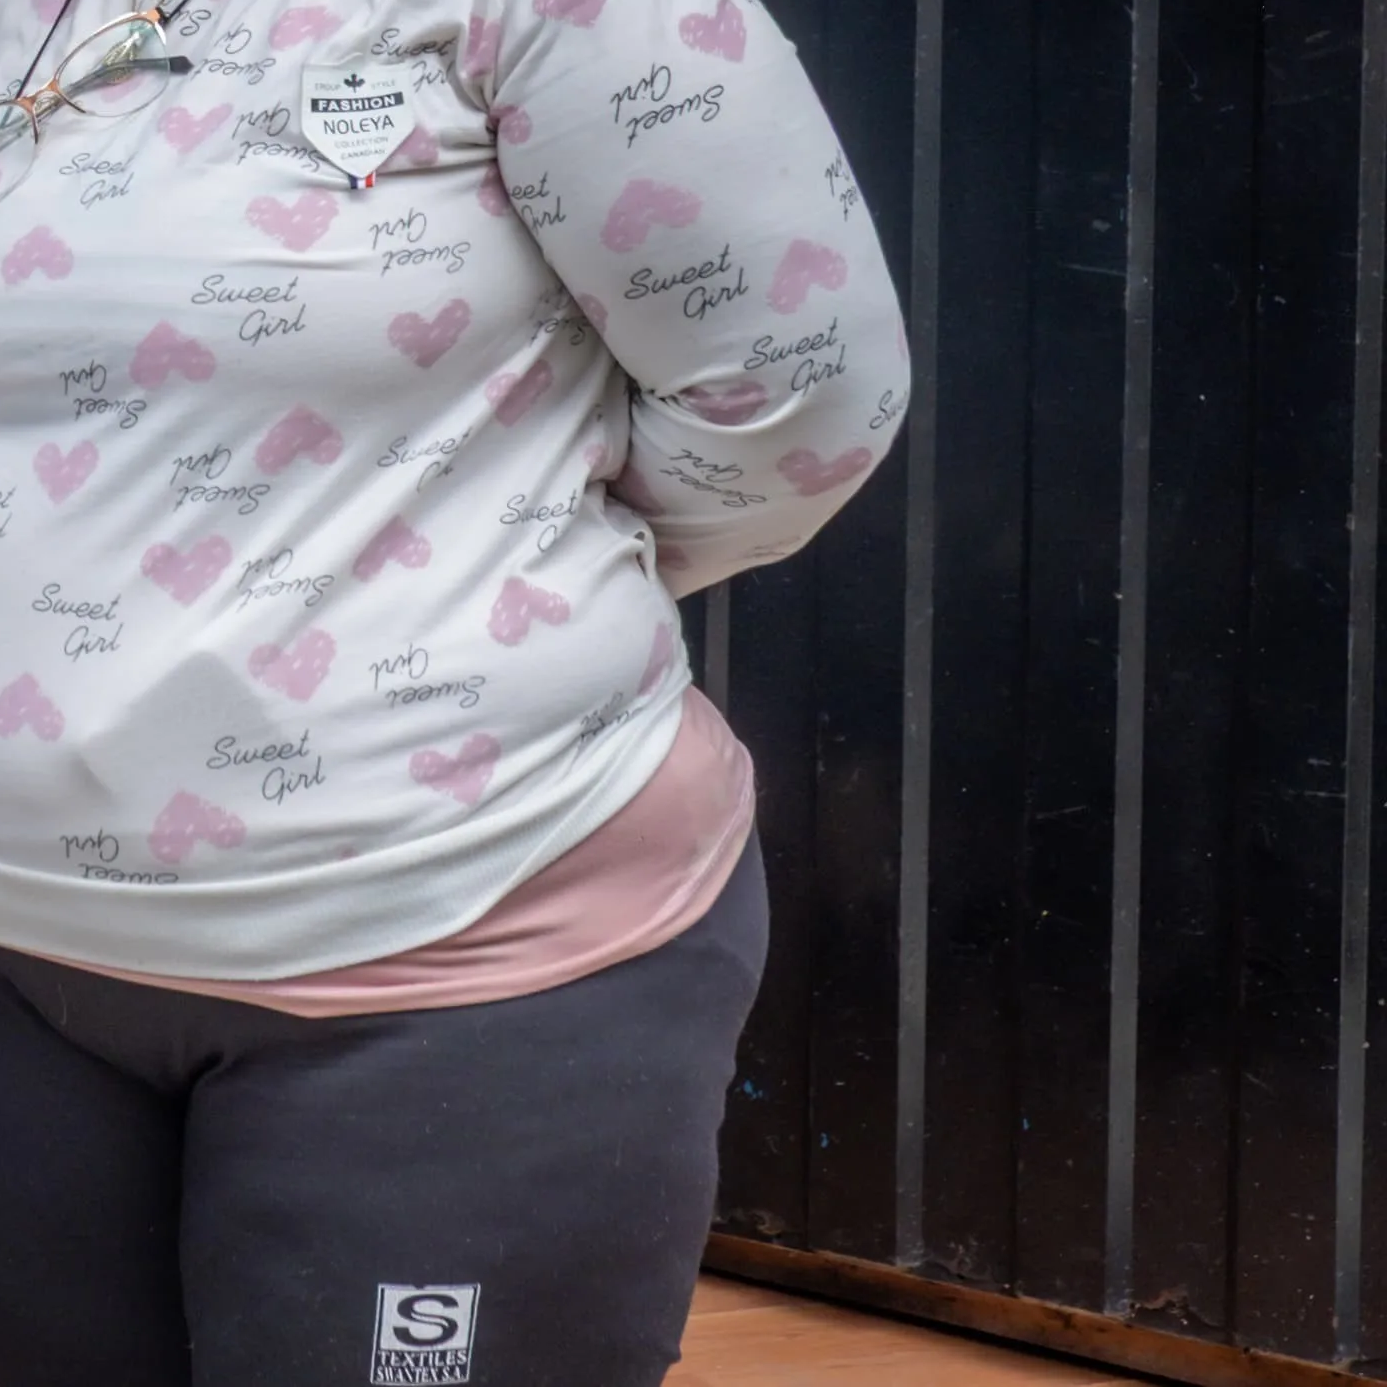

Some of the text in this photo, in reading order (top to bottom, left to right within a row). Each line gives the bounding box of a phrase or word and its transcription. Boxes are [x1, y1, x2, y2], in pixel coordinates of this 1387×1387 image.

[318, 94, 396, 112] FASHION
[610, 63, 672, 124] Girl
[232, 100, 291, 140] Girl
[323, 114, 395, 135] NOLEYA
[625, 84, 725, 149] Sweet
[238, 140, 327, 173] Sweet
[509, 171, 552, 201] eet
[369, 207, 427, 250] Girl
[381, 241, 471, 277] Sweet
[624, 243, 732, 300] Sweet
[191, 274, 299, 305] Sweet
[683, 267, 749, 320] Girl
[239, 304, 307, 347] Girl
[744, 317, 838, 370] Sweet
[60, 359, 107, 394] Girl
[791, 344, 847, 397] Girl
[73, 398, 147, 429] Sweet
[170, 444, 232, 486] Girl
[669, 448, 744, 483] Girl
[173, 483, 271, 515] Sweet
[32, 583, 121, 621] Sweet
[236, 574, 335, 613] Sweet
[63, 623, 124, 662] Girl
[369, 642, 429, 690] Girl
[386, 675, 486, 709] Sweet
[206, 729, 310, 770] Sweet
[262, 756, 326, 805] Girl
[60, 827, 119, 863] Girl
[377, 1349, 467, 1367] TEXTILES
